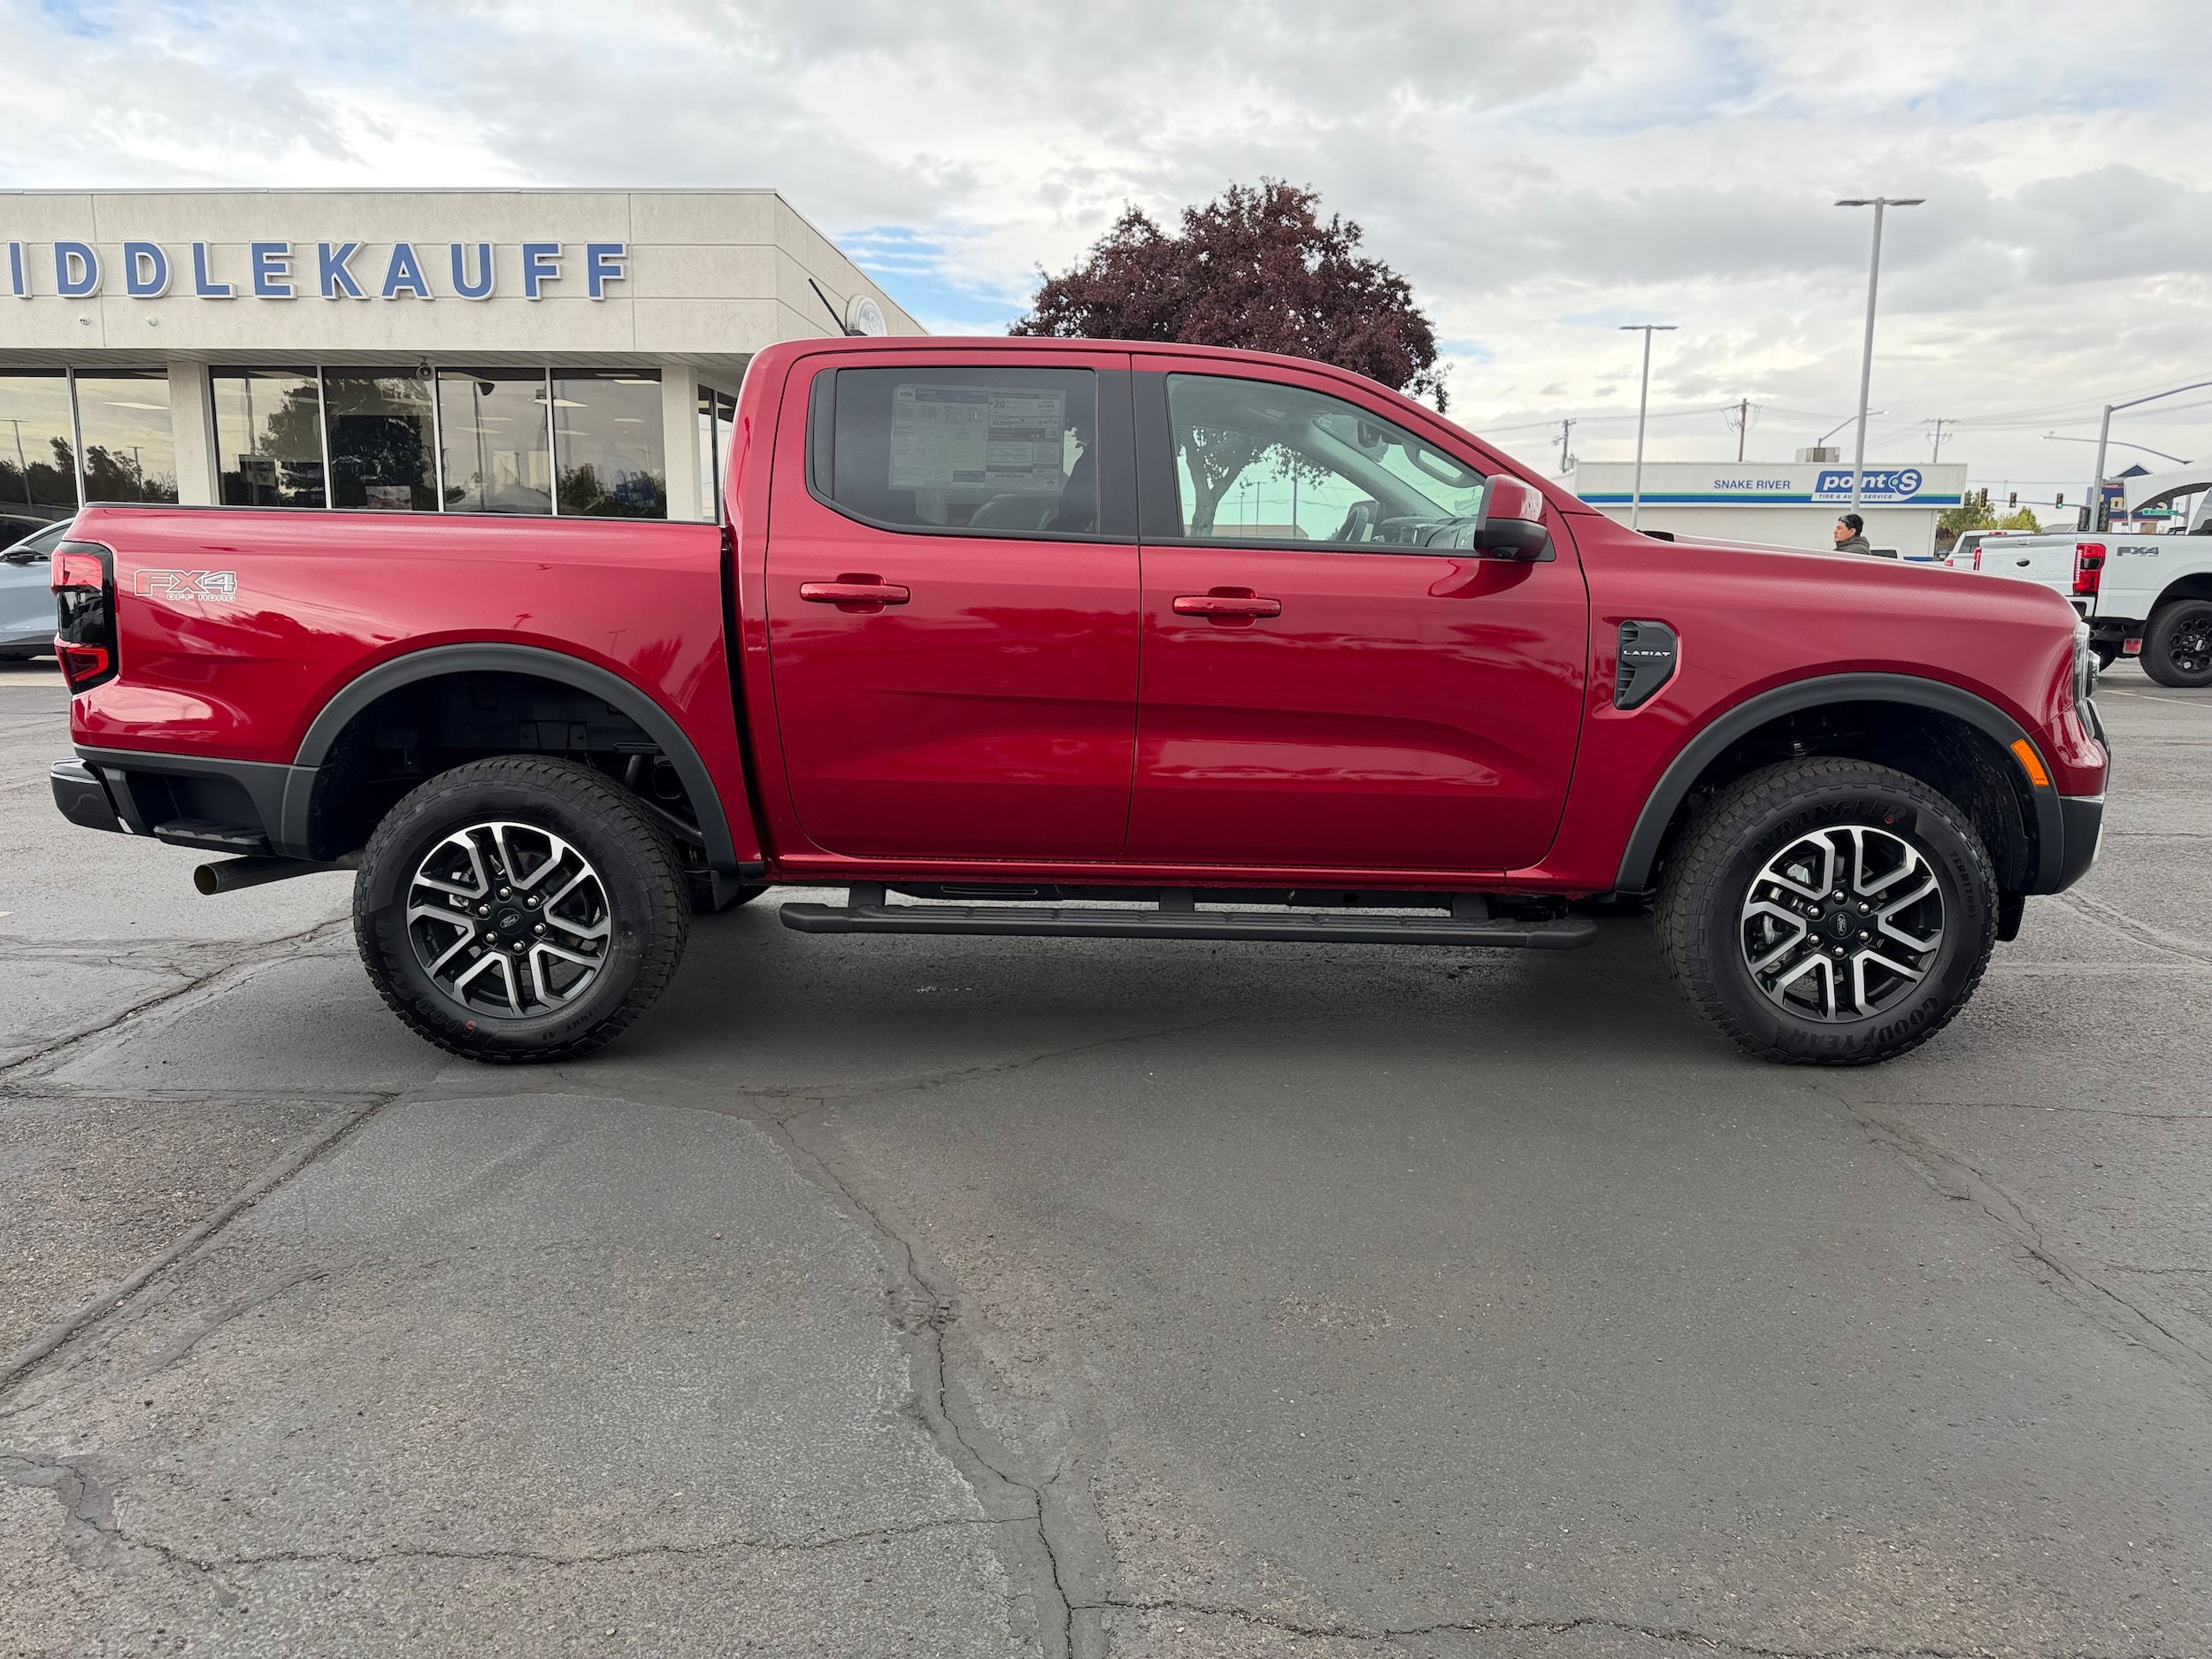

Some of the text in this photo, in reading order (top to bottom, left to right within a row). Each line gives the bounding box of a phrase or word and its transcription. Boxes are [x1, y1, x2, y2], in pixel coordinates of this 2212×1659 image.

[1714, 480, 1791, 489] SNAKE RIVER
[1823, 473, 1887, 491] pont
[2116, 546, 2159, 557] FX4
[134, 568, 237, 596] FX4
[165, 593, 236, 603] OFF ROAD
[1949, 850, 1976, 921] TERRITORY
